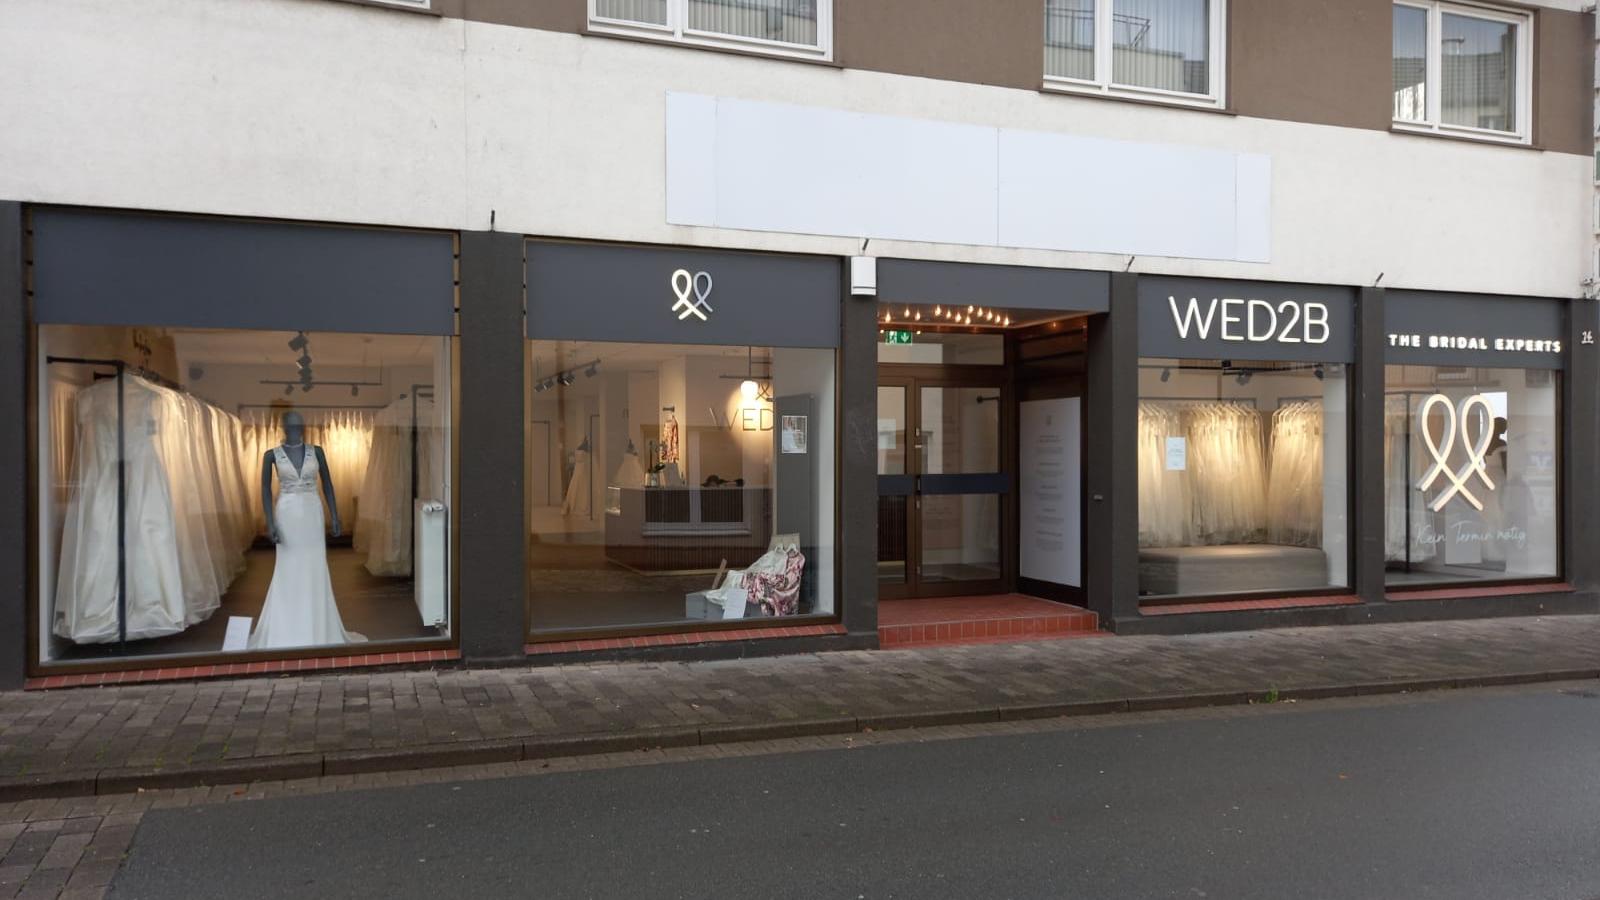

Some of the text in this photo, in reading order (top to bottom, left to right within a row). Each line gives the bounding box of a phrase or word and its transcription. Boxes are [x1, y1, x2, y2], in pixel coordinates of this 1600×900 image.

[1168, 295, 1330, 344] WED2B
[1388, 333, 1562, 353] THE BRIDAL EXPERTS
